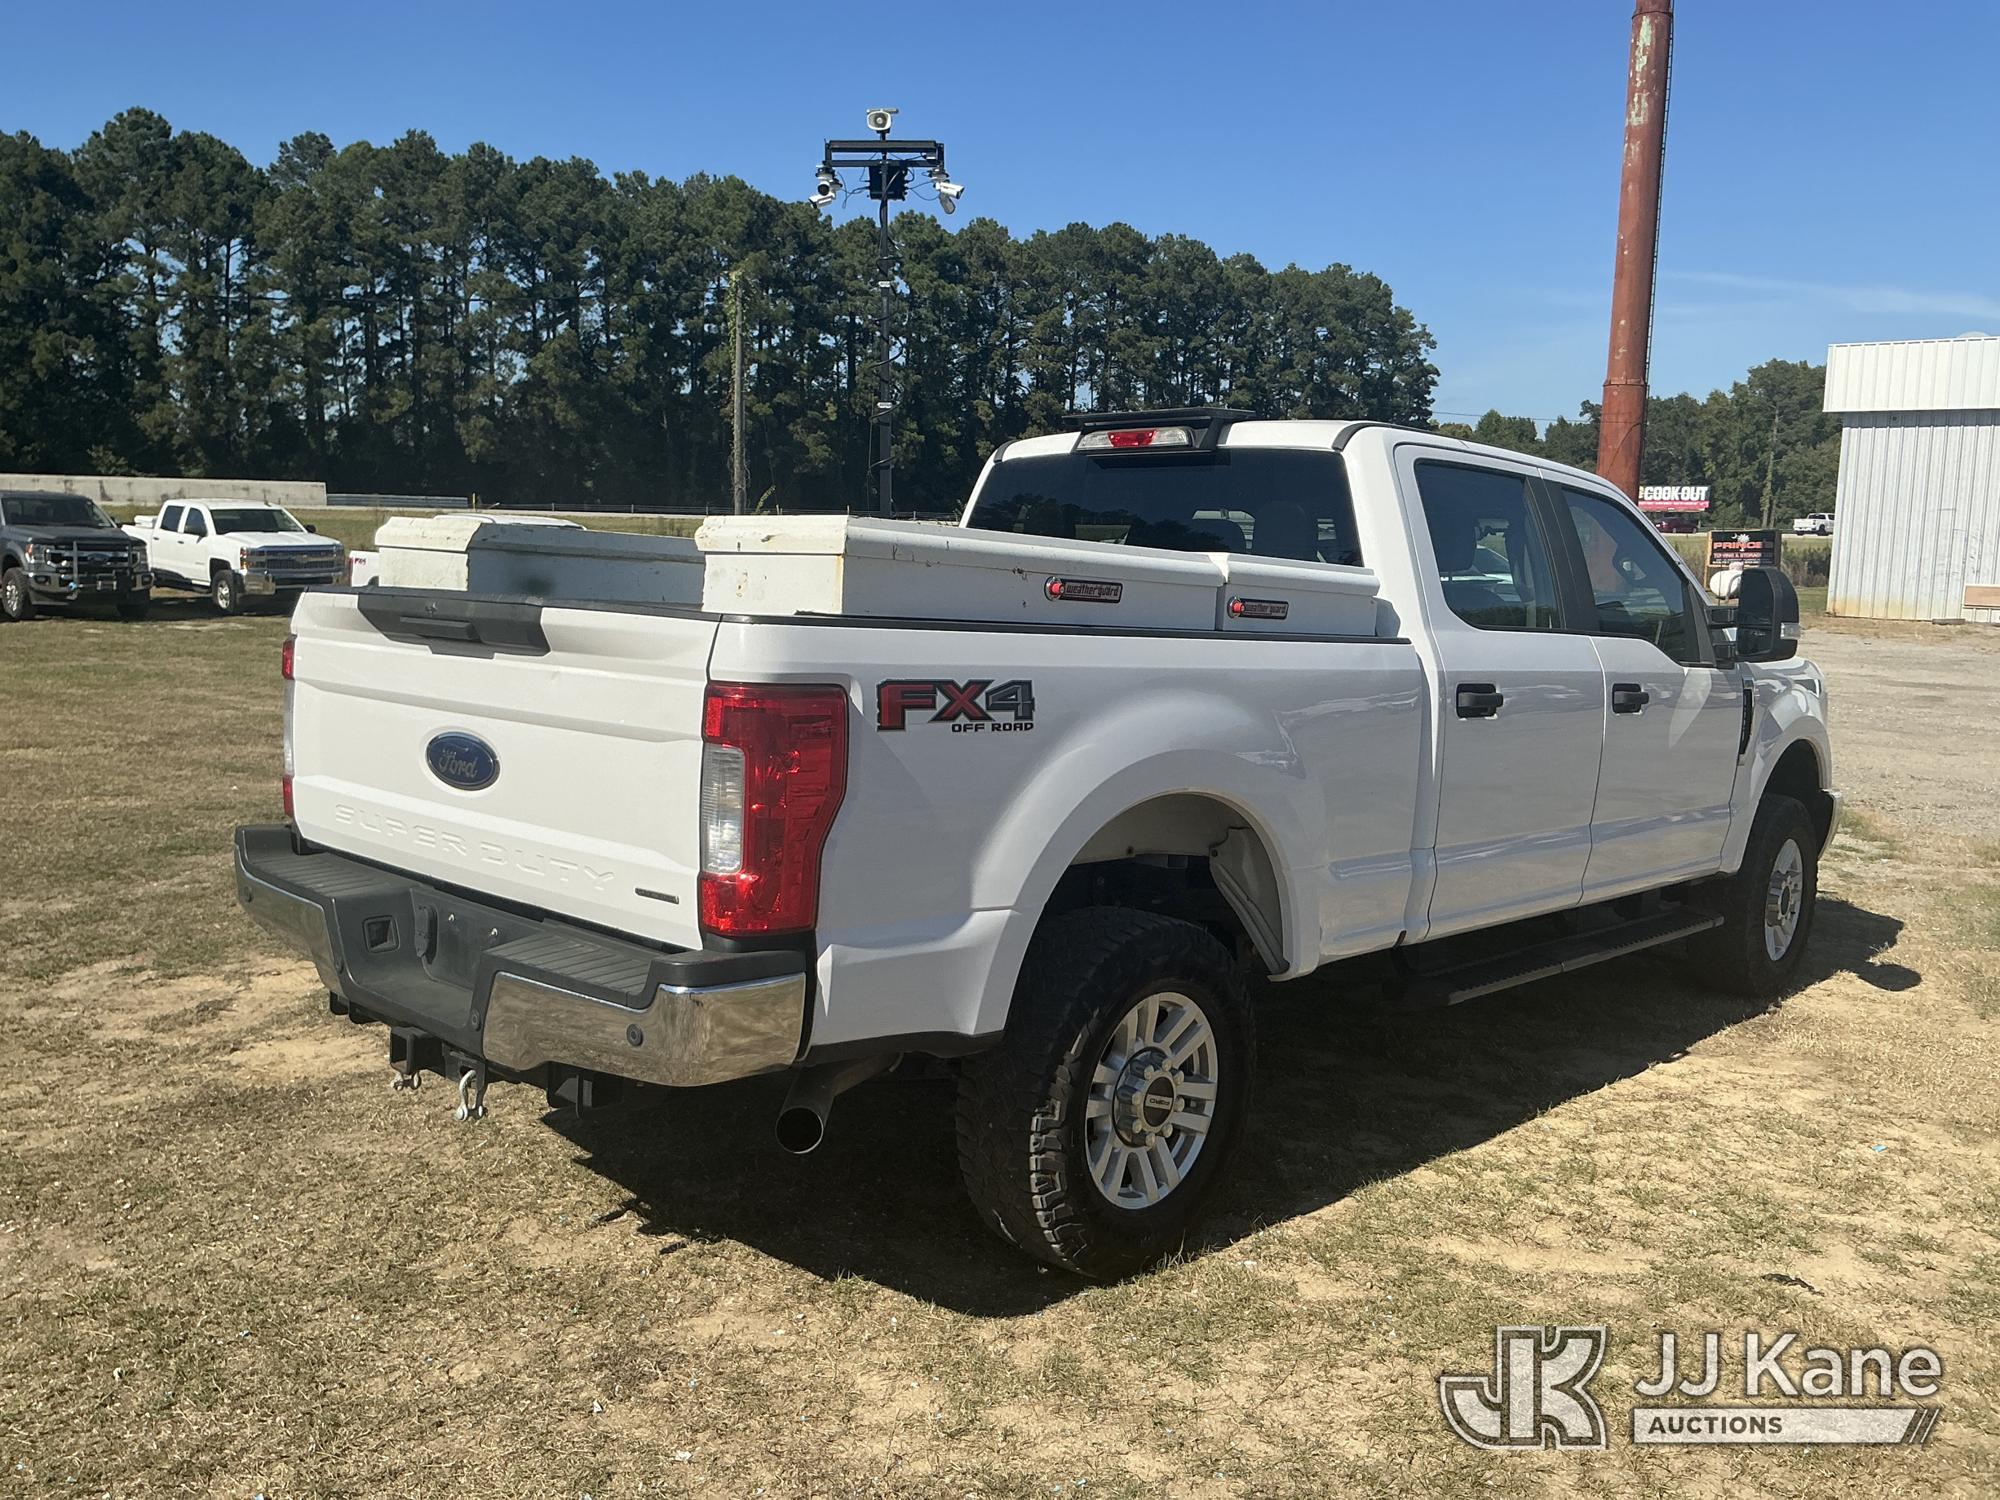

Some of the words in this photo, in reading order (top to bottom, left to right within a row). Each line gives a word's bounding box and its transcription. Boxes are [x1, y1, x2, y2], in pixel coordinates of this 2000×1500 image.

[877, 679, 1035, 732] FX4
[951, 723, 985, 733] OFF
[991, 722, 1034, 732] ROAD
[438, 747, 479, 778] Ford
[334, 803, 468, 857] SUPER
[479, 840, 616, 891] DUTY
